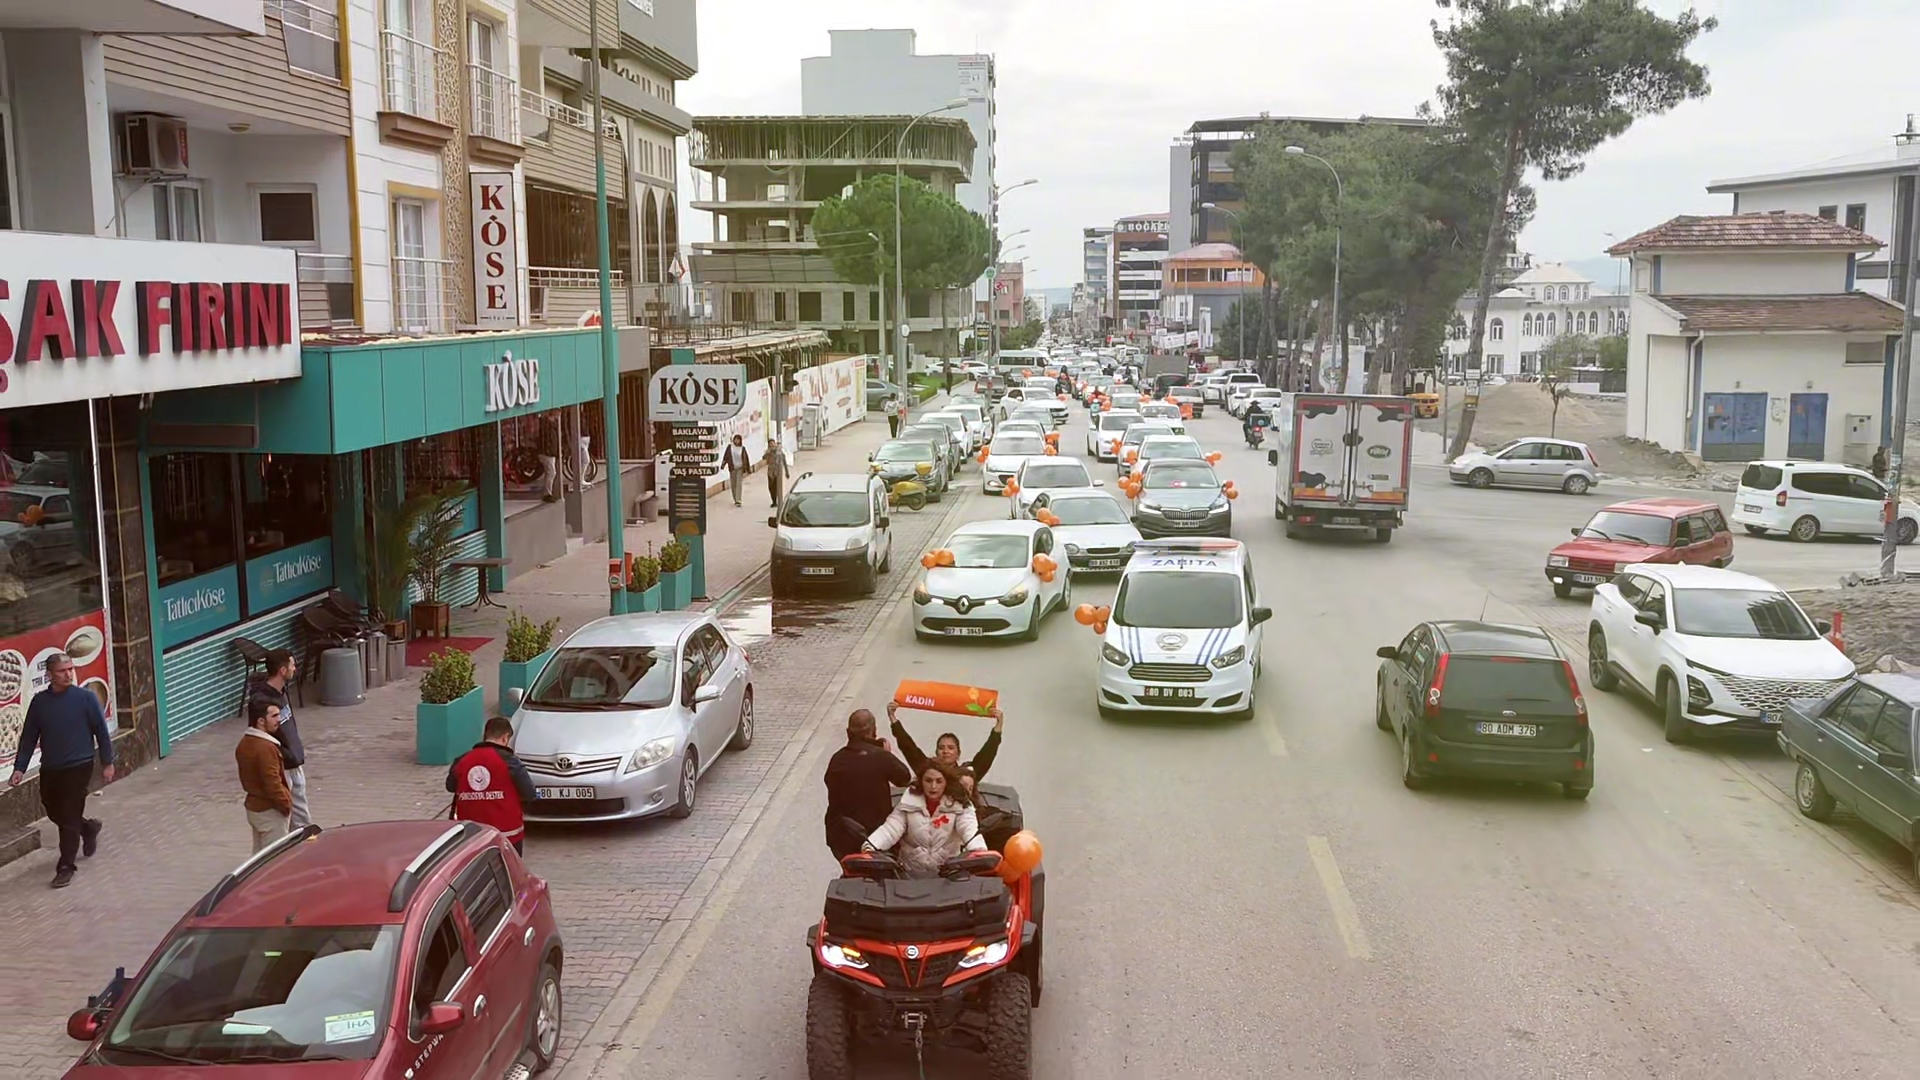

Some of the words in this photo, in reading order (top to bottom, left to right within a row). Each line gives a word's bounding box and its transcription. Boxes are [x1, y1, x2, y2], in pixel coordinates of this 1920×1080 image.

[135, 281, 292, 357] FIRINI
[672, 428, 708, 436] BAKLAVA
[676, 440, 706, 449] KÜNEFE
[673, 468, 686, 477] YAŞ
[905, 694, 935, 707] KADIN
[1482, 723, 1493, 733] 80
[1497, 724, 1514, 734] ADM
[1518, 725, 1535, 735] 376
[541, 788, 552, 797] 80
[559, 788, 570, 798] KJ
[576, 788, 592, 798] 005
